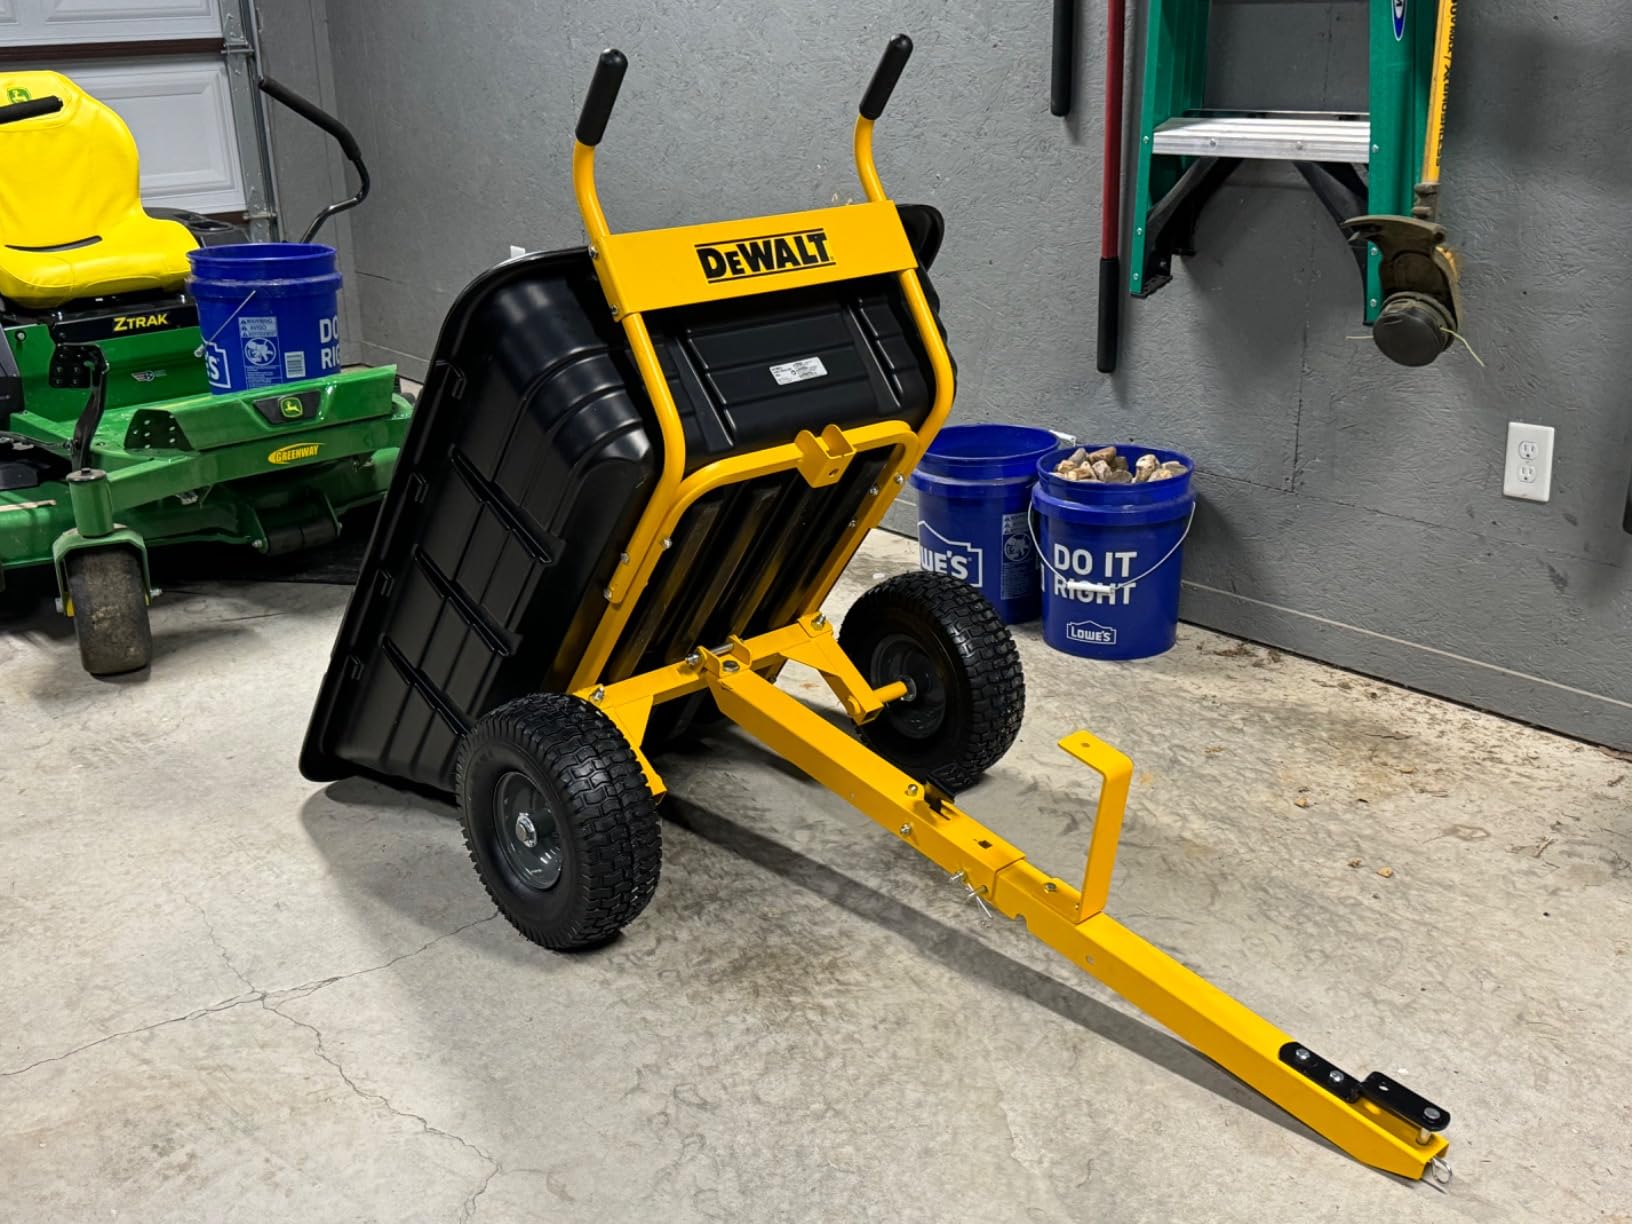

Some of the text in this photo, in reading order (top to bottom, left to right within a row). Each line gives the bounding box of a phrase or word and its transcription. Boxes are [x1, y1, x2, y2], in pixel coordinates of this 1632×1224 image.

[113, 313, 168, 332] ZTRAK
[275, 445, 319, 463] GREENWAY
[920, 545, 969, 580] WE'S
[1054, 543, 1138, 578] DO IT
[1054, 573, 1137, 605] RIGHT
[1070, 626, 1112, 642] LOWE'S
